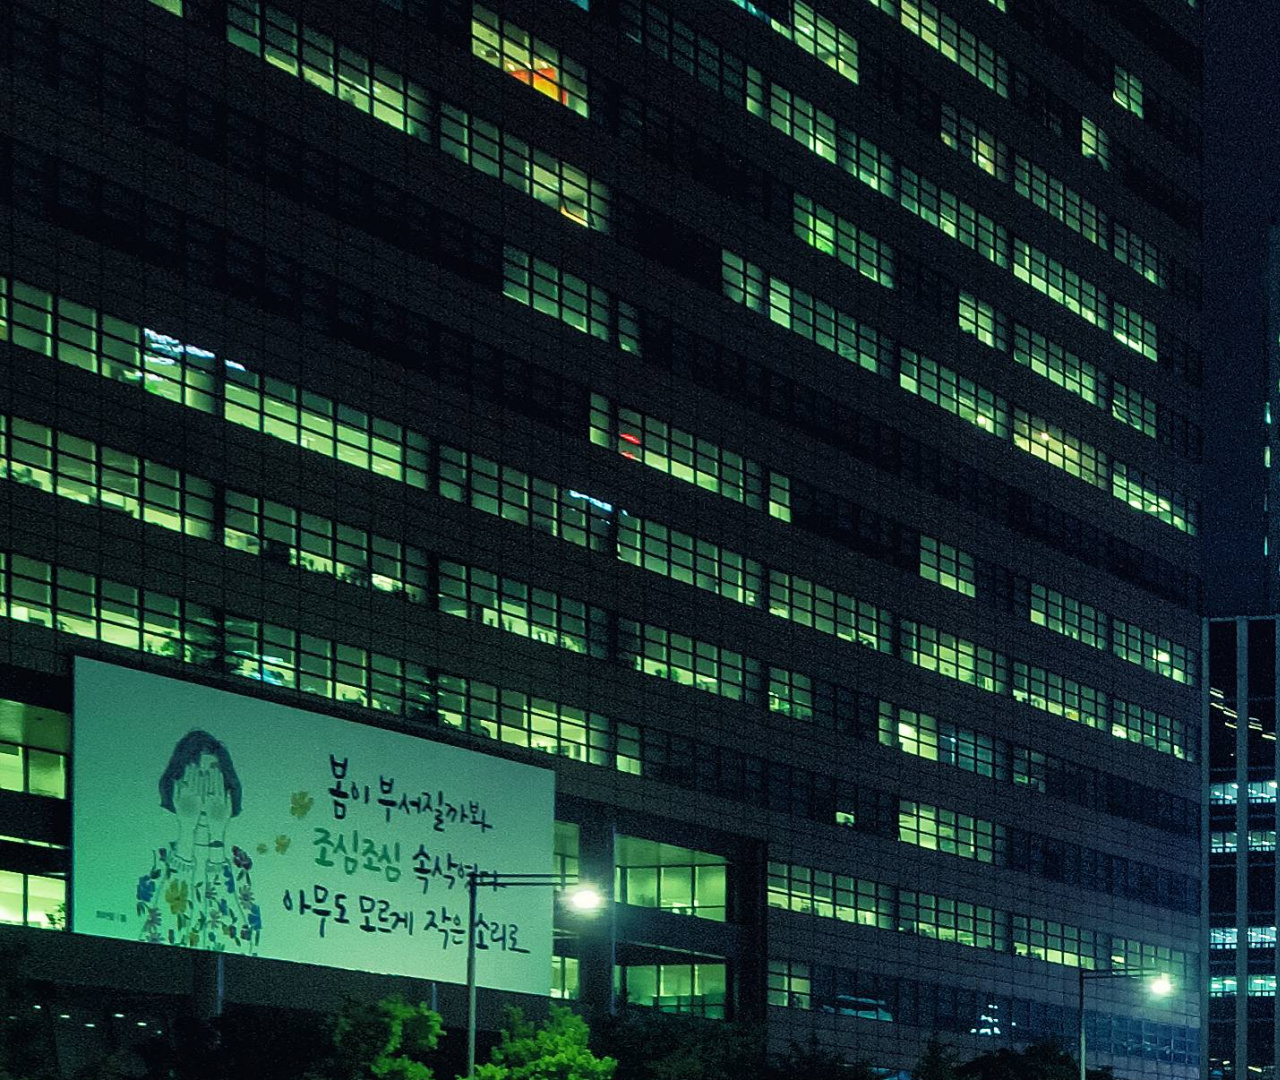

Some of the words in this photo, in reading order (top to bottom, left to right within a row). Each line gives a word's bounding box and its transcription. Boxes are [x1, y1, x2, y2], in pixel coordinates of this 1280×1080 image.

[329, 754, 370, 820] 봄이
[377, 775, 493, 832] 부서질까봐
[313, 827, 401, 882] 조심조심
[282, 884, 350, 938] 아무도
[359, 895, 413, 935] 모르게
[424, 906, 466, 950] 작은
[474, 912, 531, 954] 소리로
